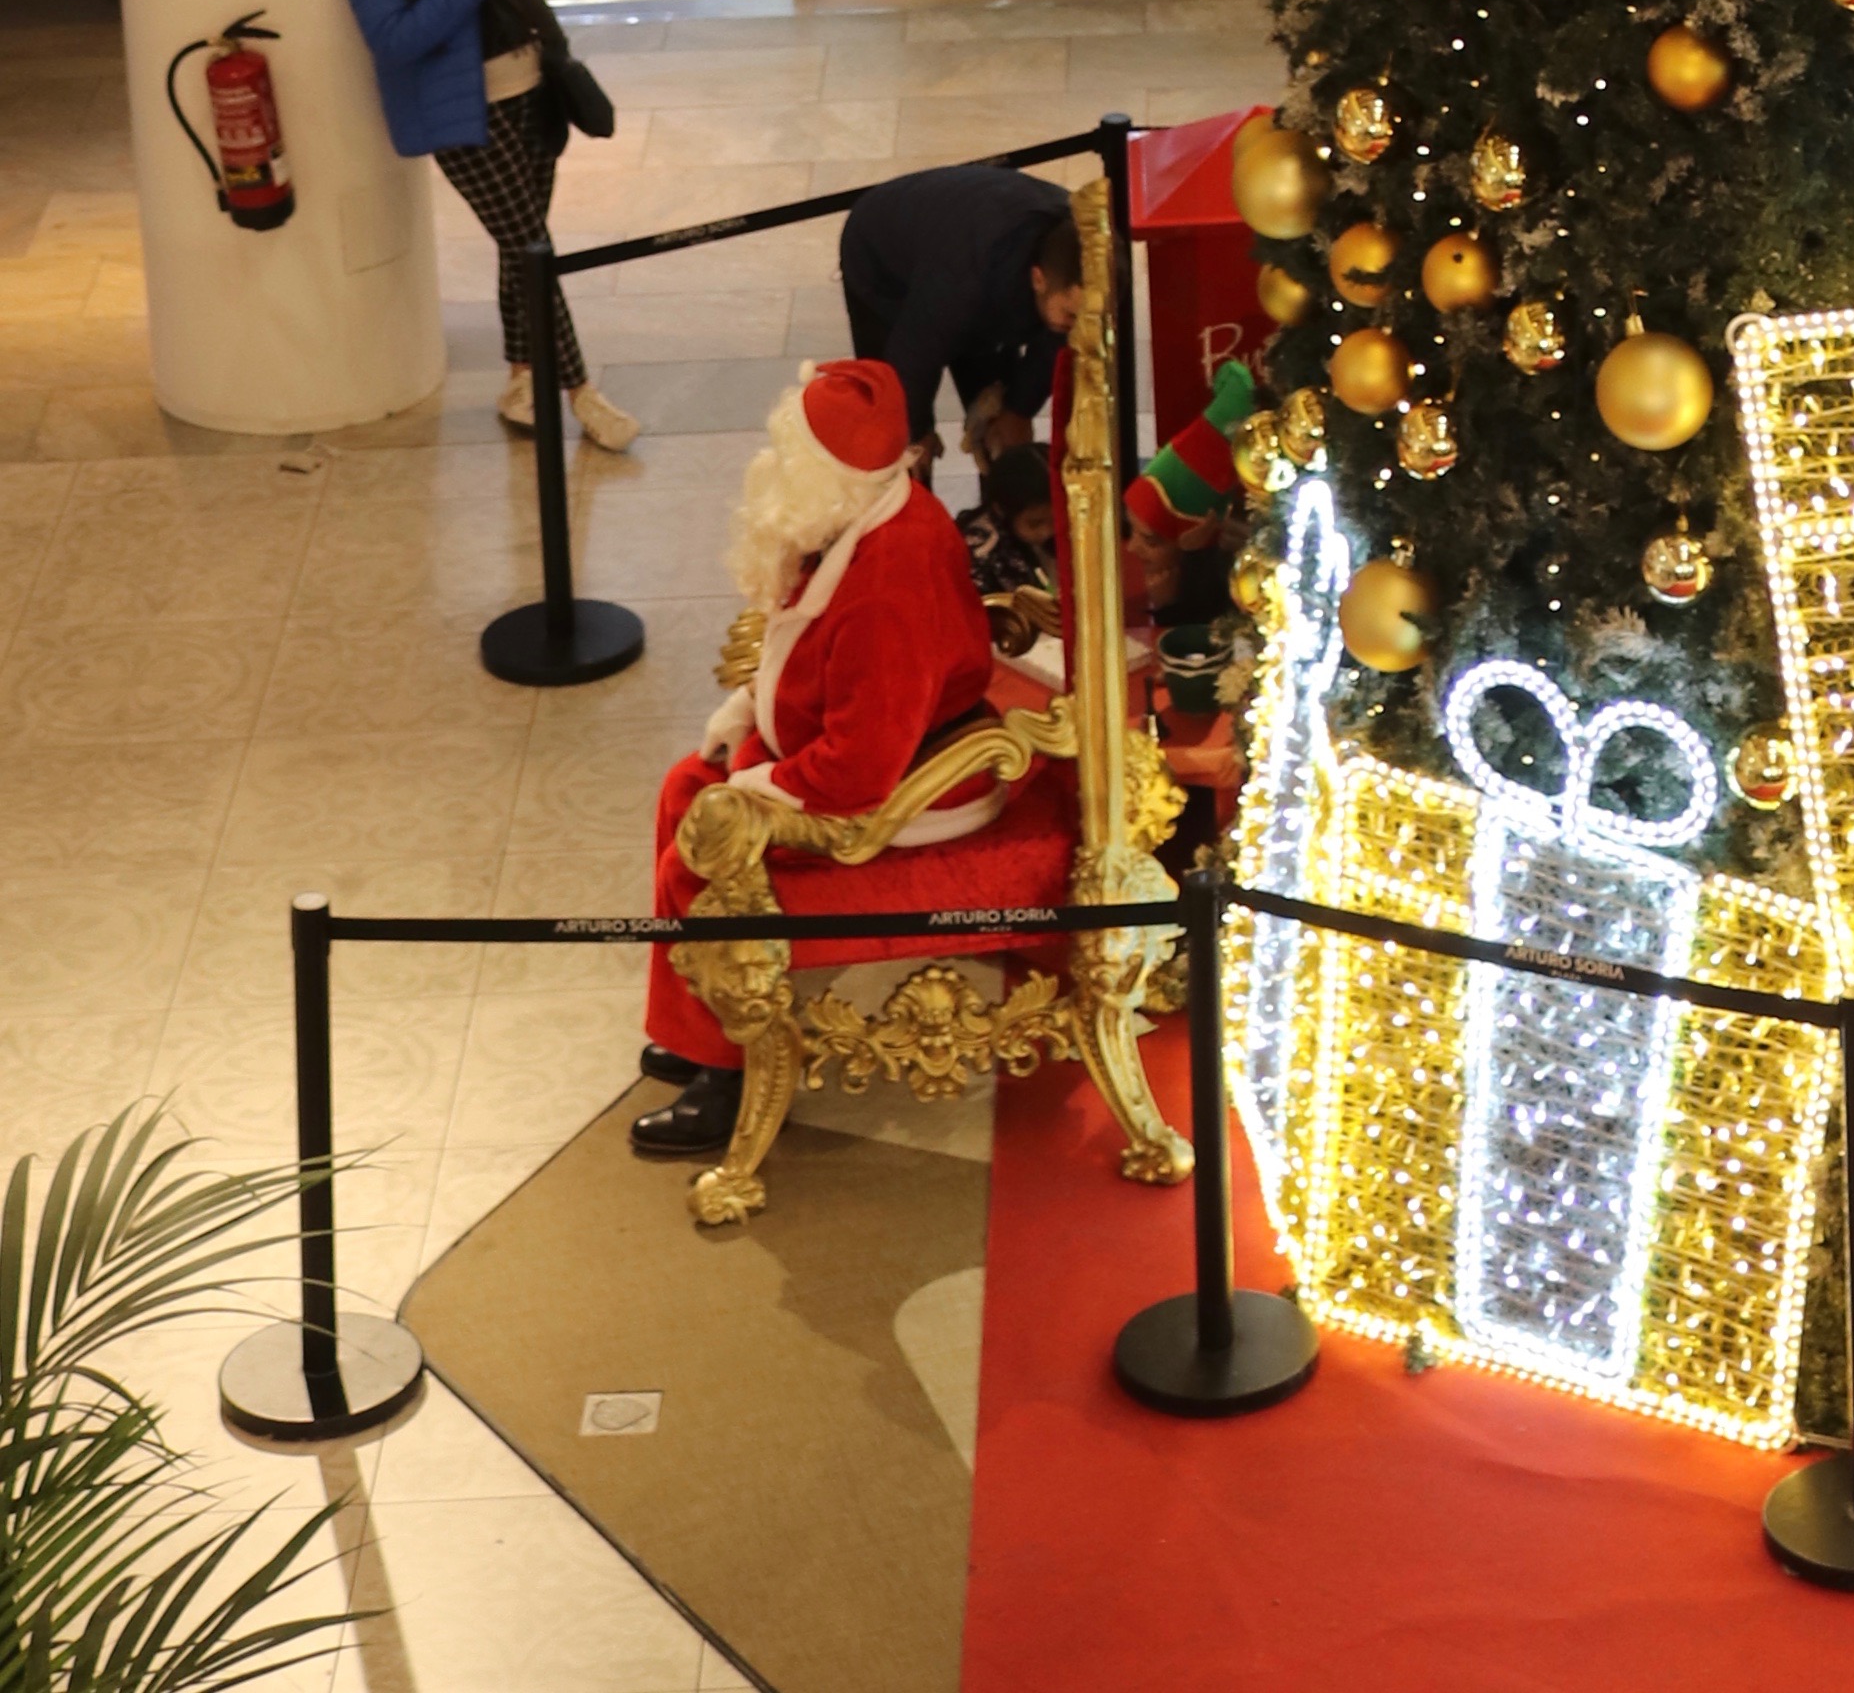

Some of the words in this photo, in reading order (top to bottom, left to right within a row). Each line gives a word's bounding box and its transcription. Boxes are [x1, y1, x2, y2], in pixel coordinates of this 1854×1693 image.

[928, 909, 1001, 926] ARTURO
[1003, 907, 1058, 923] SORIA
[1504, 945, 1573, 970] ARTURO
[1574, 955, 1626, 982] SORIA
